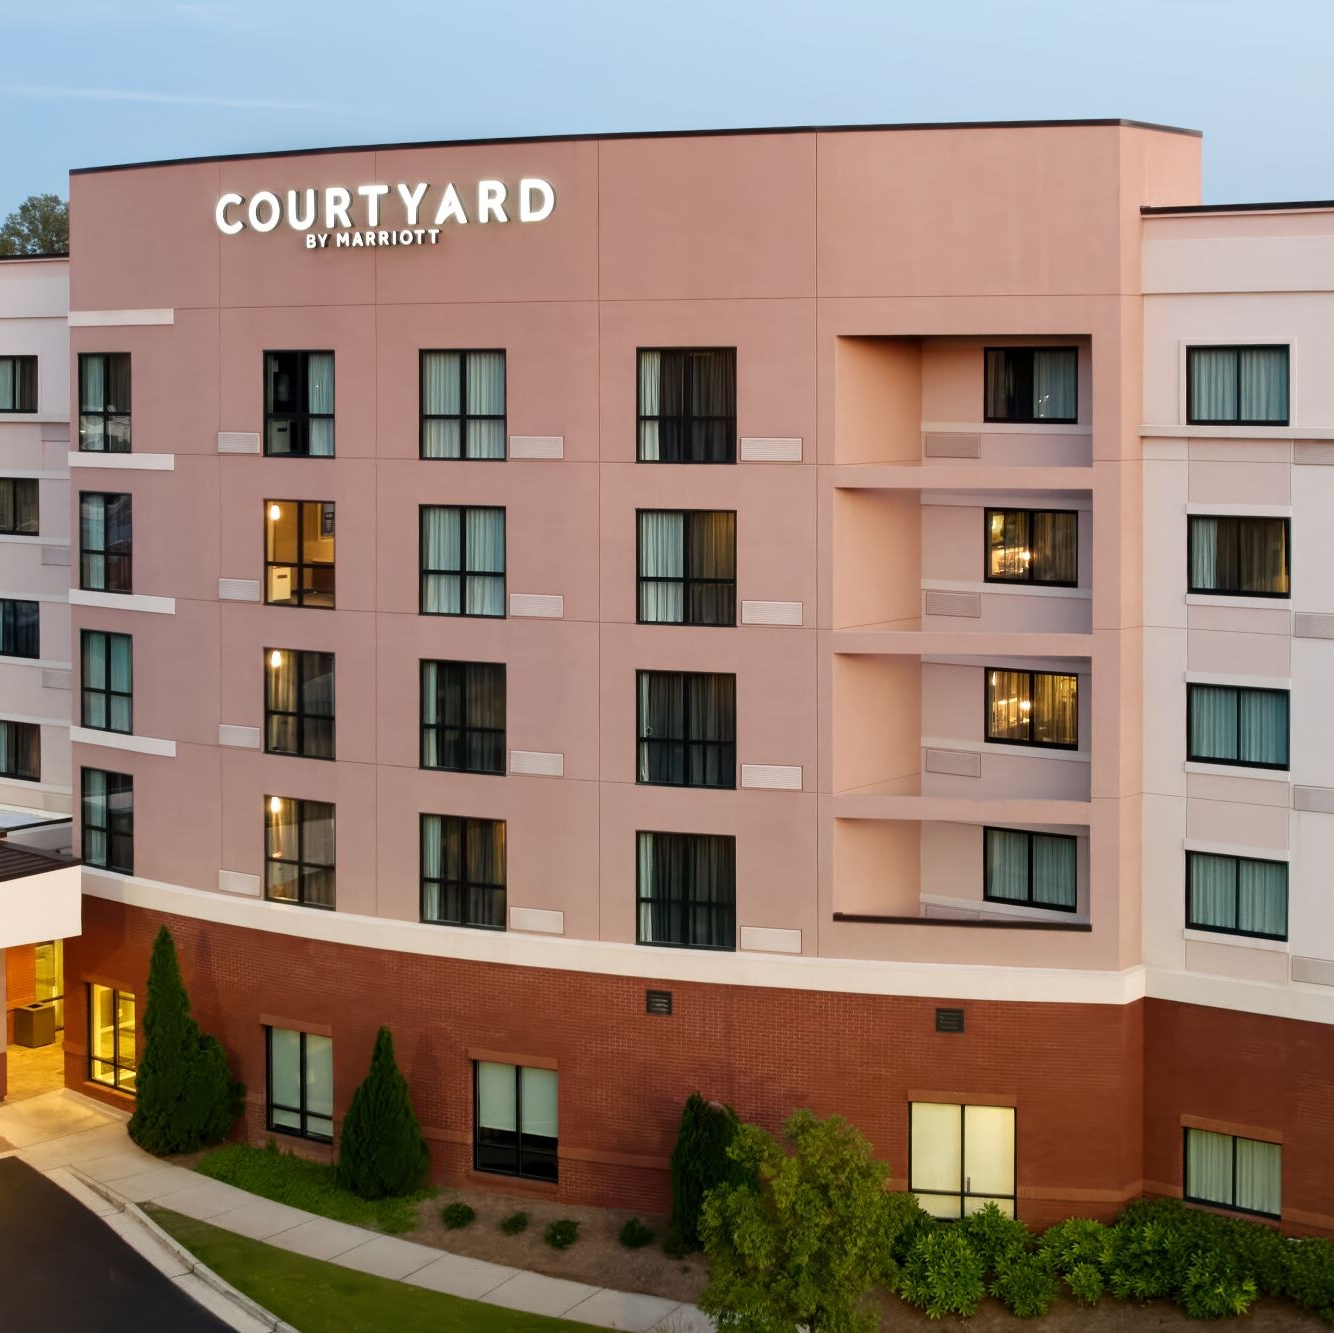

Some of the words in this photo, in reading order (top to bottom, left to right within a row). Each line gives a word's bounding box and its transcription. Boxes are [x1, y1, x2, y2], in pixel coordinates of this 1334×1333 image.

[215, 178, 556, 235] COURTYARD
[306, 233, 329, 249] BY
[336, 228, 441, 248] MARRIOTT
